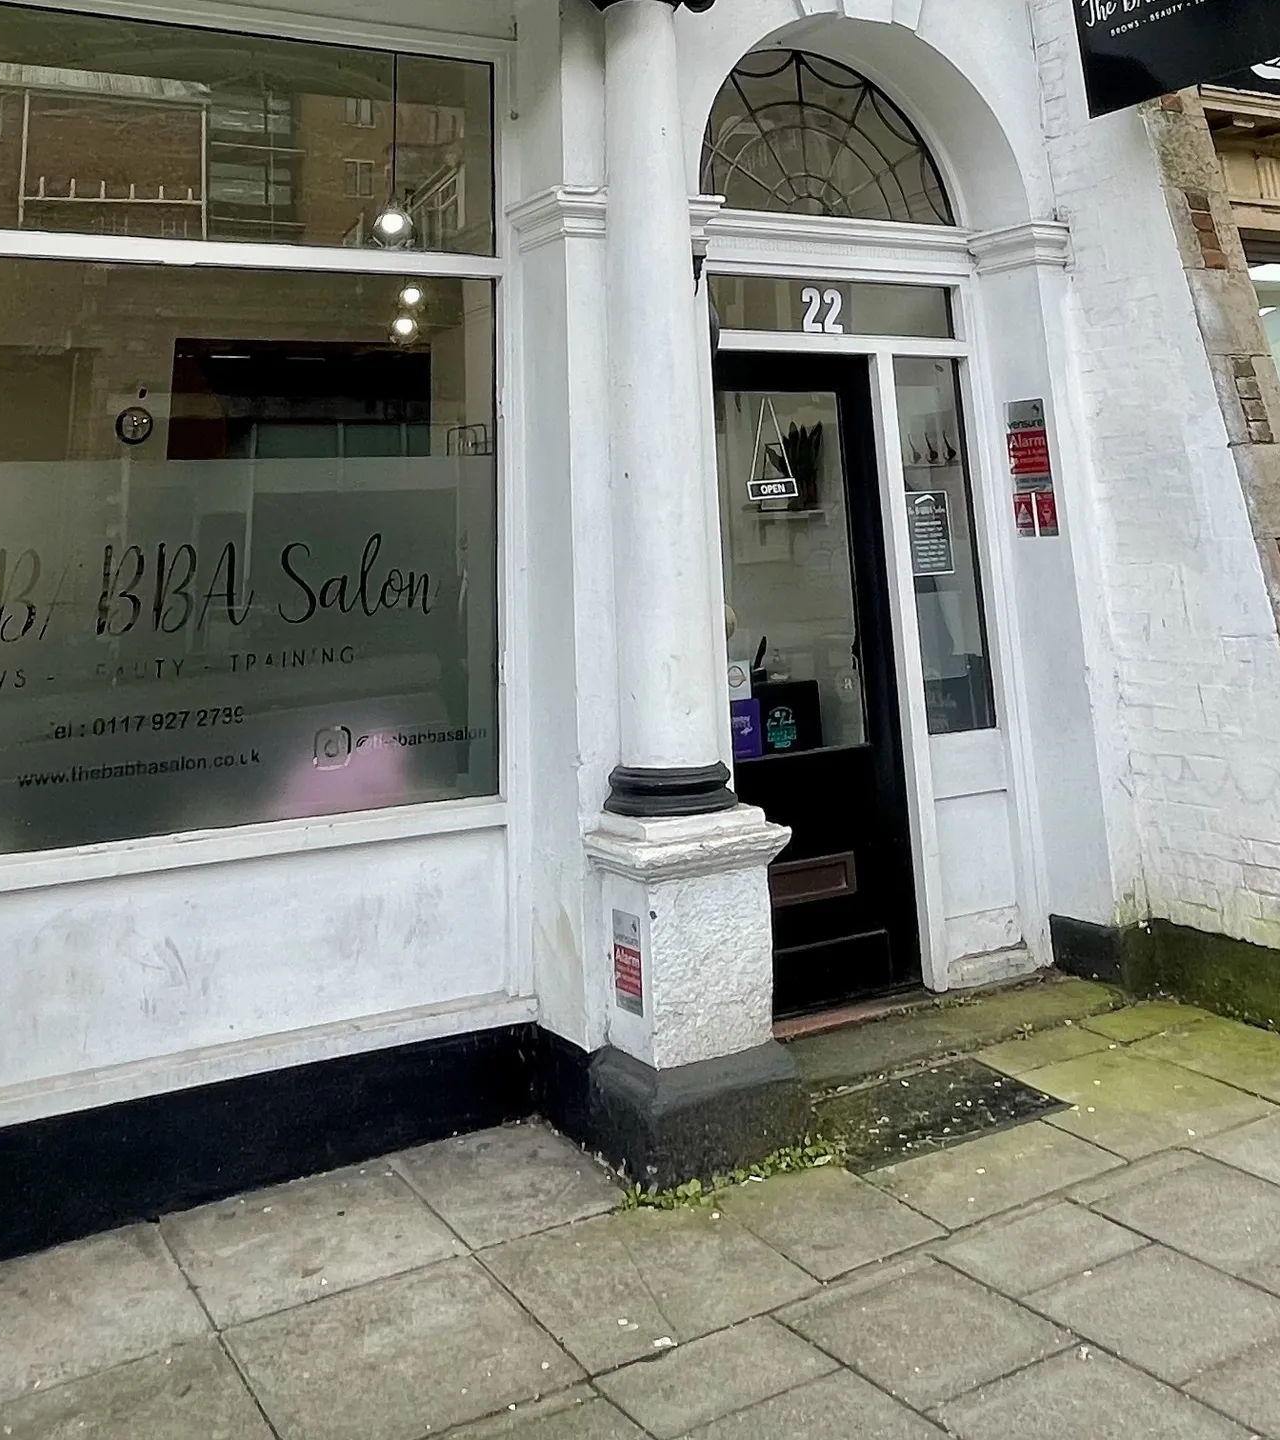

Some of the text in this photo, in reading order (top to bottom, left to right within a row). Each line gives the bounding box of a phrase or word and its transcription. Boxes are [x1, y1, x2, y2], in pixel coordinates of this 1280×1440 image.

[1109, 21, 1140, 37] BROWS
[1149, 3, 1183, 23] BEAUTY
[802, 286, 844, 334] 22
[1009, 434, 1046, 449] Alarm
[760, 483, 787, 495] OPEN
[277, 532, 442, 625] Salon
[229, 645, 355, 673] TRAINNG
[51, 721, 72, 740] el
[92, 714, 145, 736] 0117
[151, 710, 190, 732] 927
